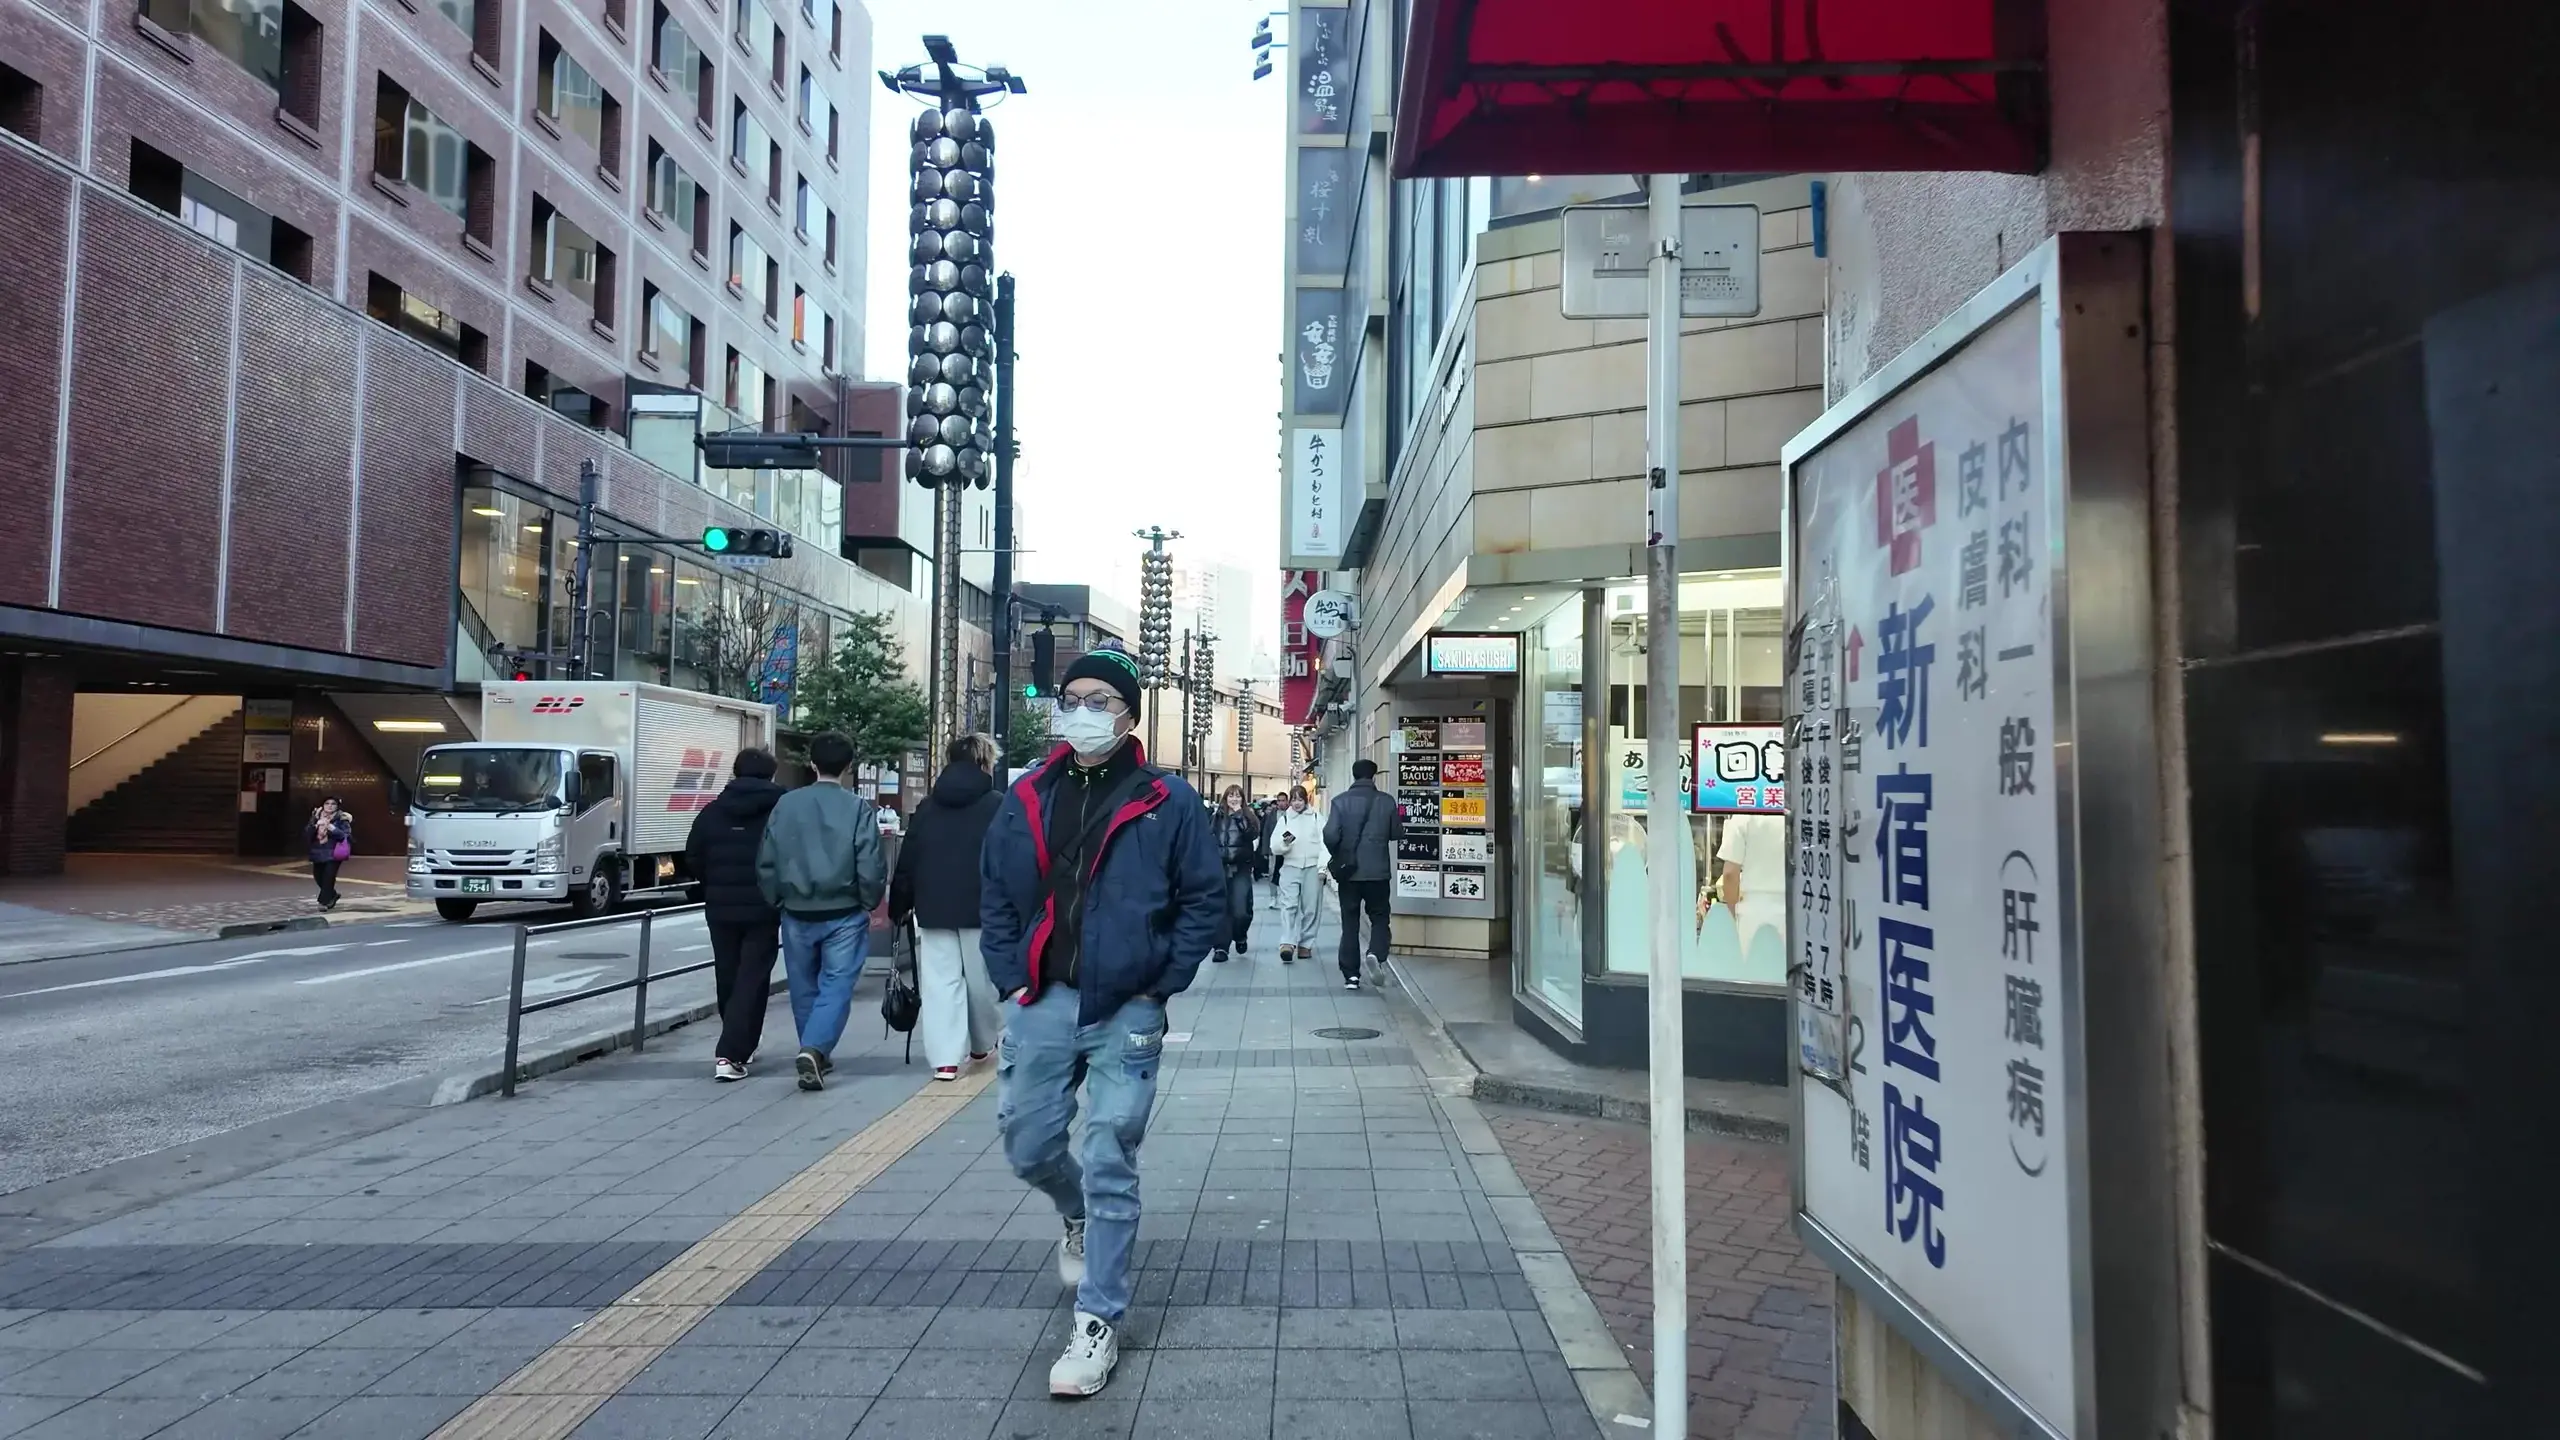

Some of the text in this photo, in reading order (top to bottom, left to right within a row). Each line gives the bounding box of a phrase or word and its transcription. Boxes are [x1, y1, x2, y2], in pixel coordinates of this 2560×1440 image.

[1890, 456, 1920, 539] 医
[1956, 439, 1989, 702] 皮膚科
[1874, 592, 1946, 1270] 新宿医院
